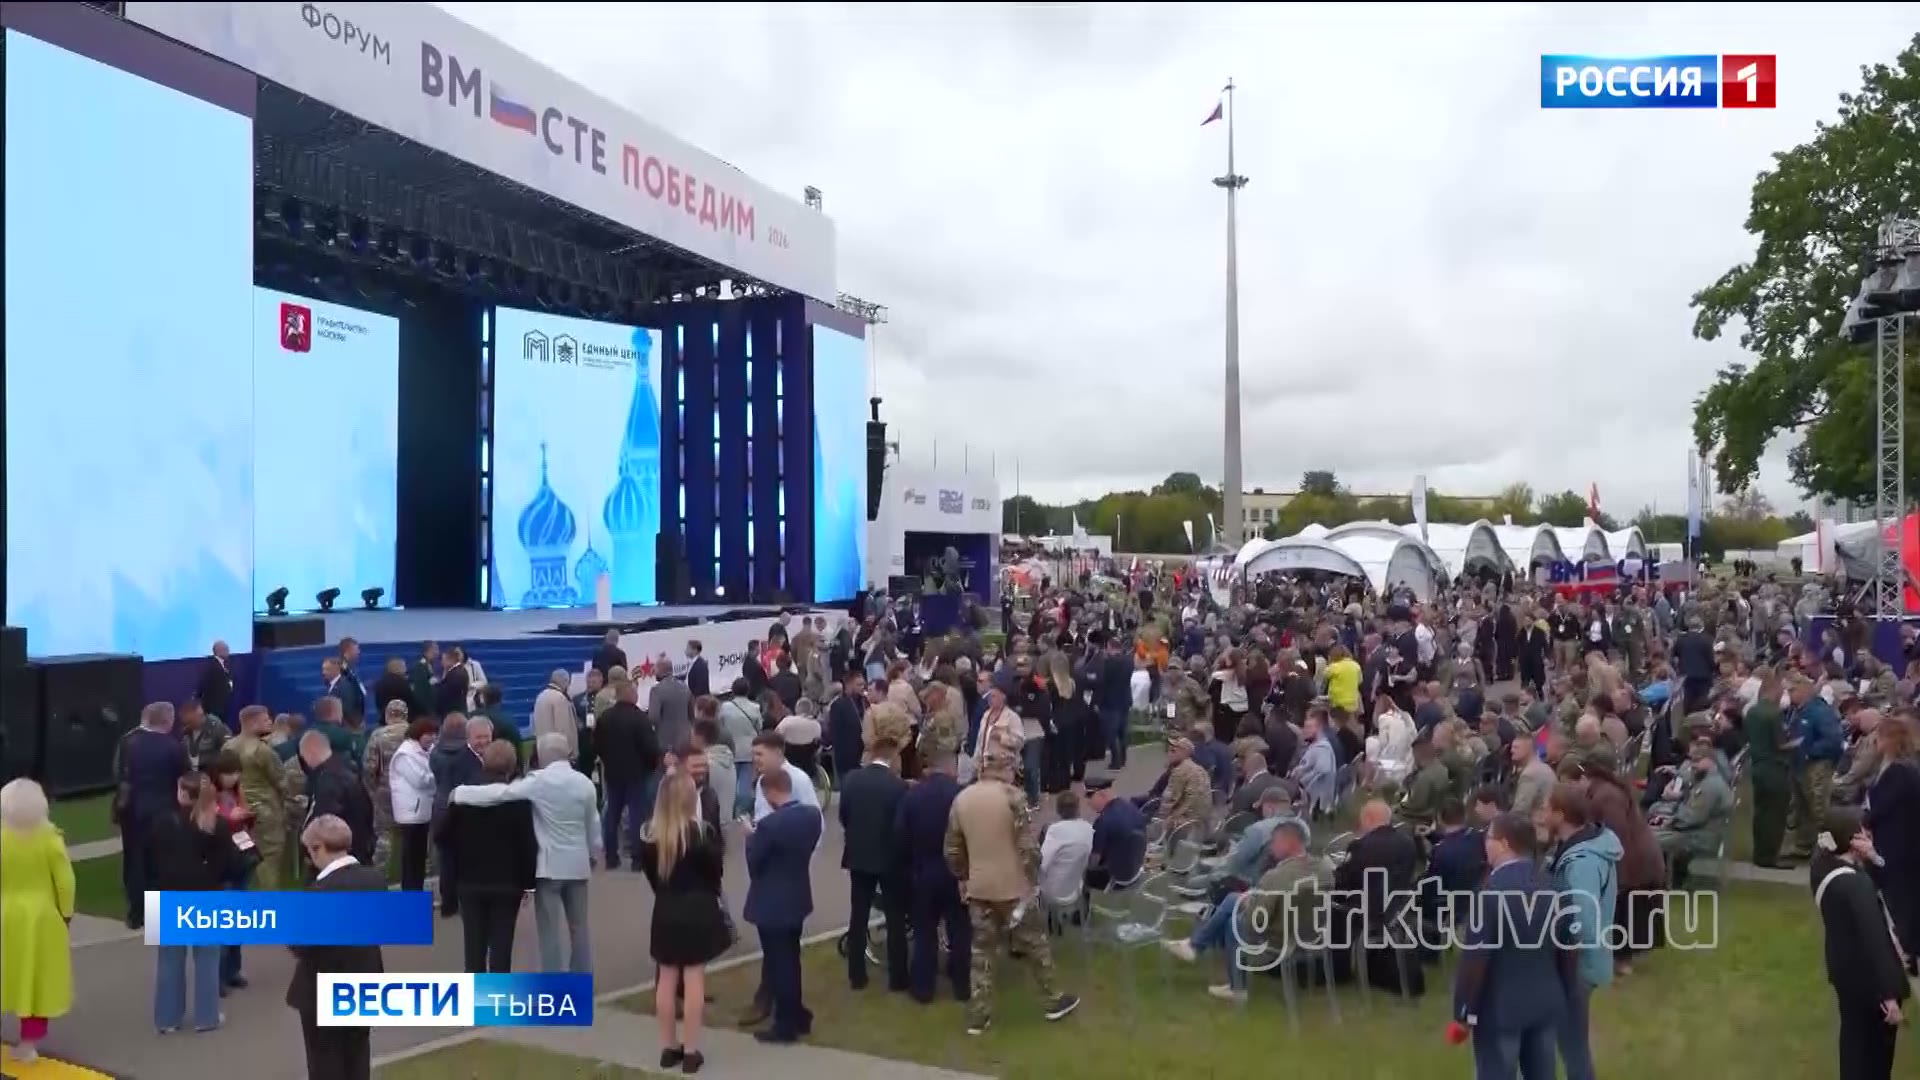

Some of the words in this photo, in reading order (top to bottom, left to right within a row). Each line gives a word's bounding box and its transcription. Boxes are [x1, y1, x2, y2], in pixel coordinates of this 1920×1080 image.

[302, 4, 390, 65] ФОРУМ
[623, 143, 755, 241] ПОБЕДИМ
[582, 342, 619, 357] ЕДИНЫЙ
[620, 347, 642, 360] ЦЕНТ
